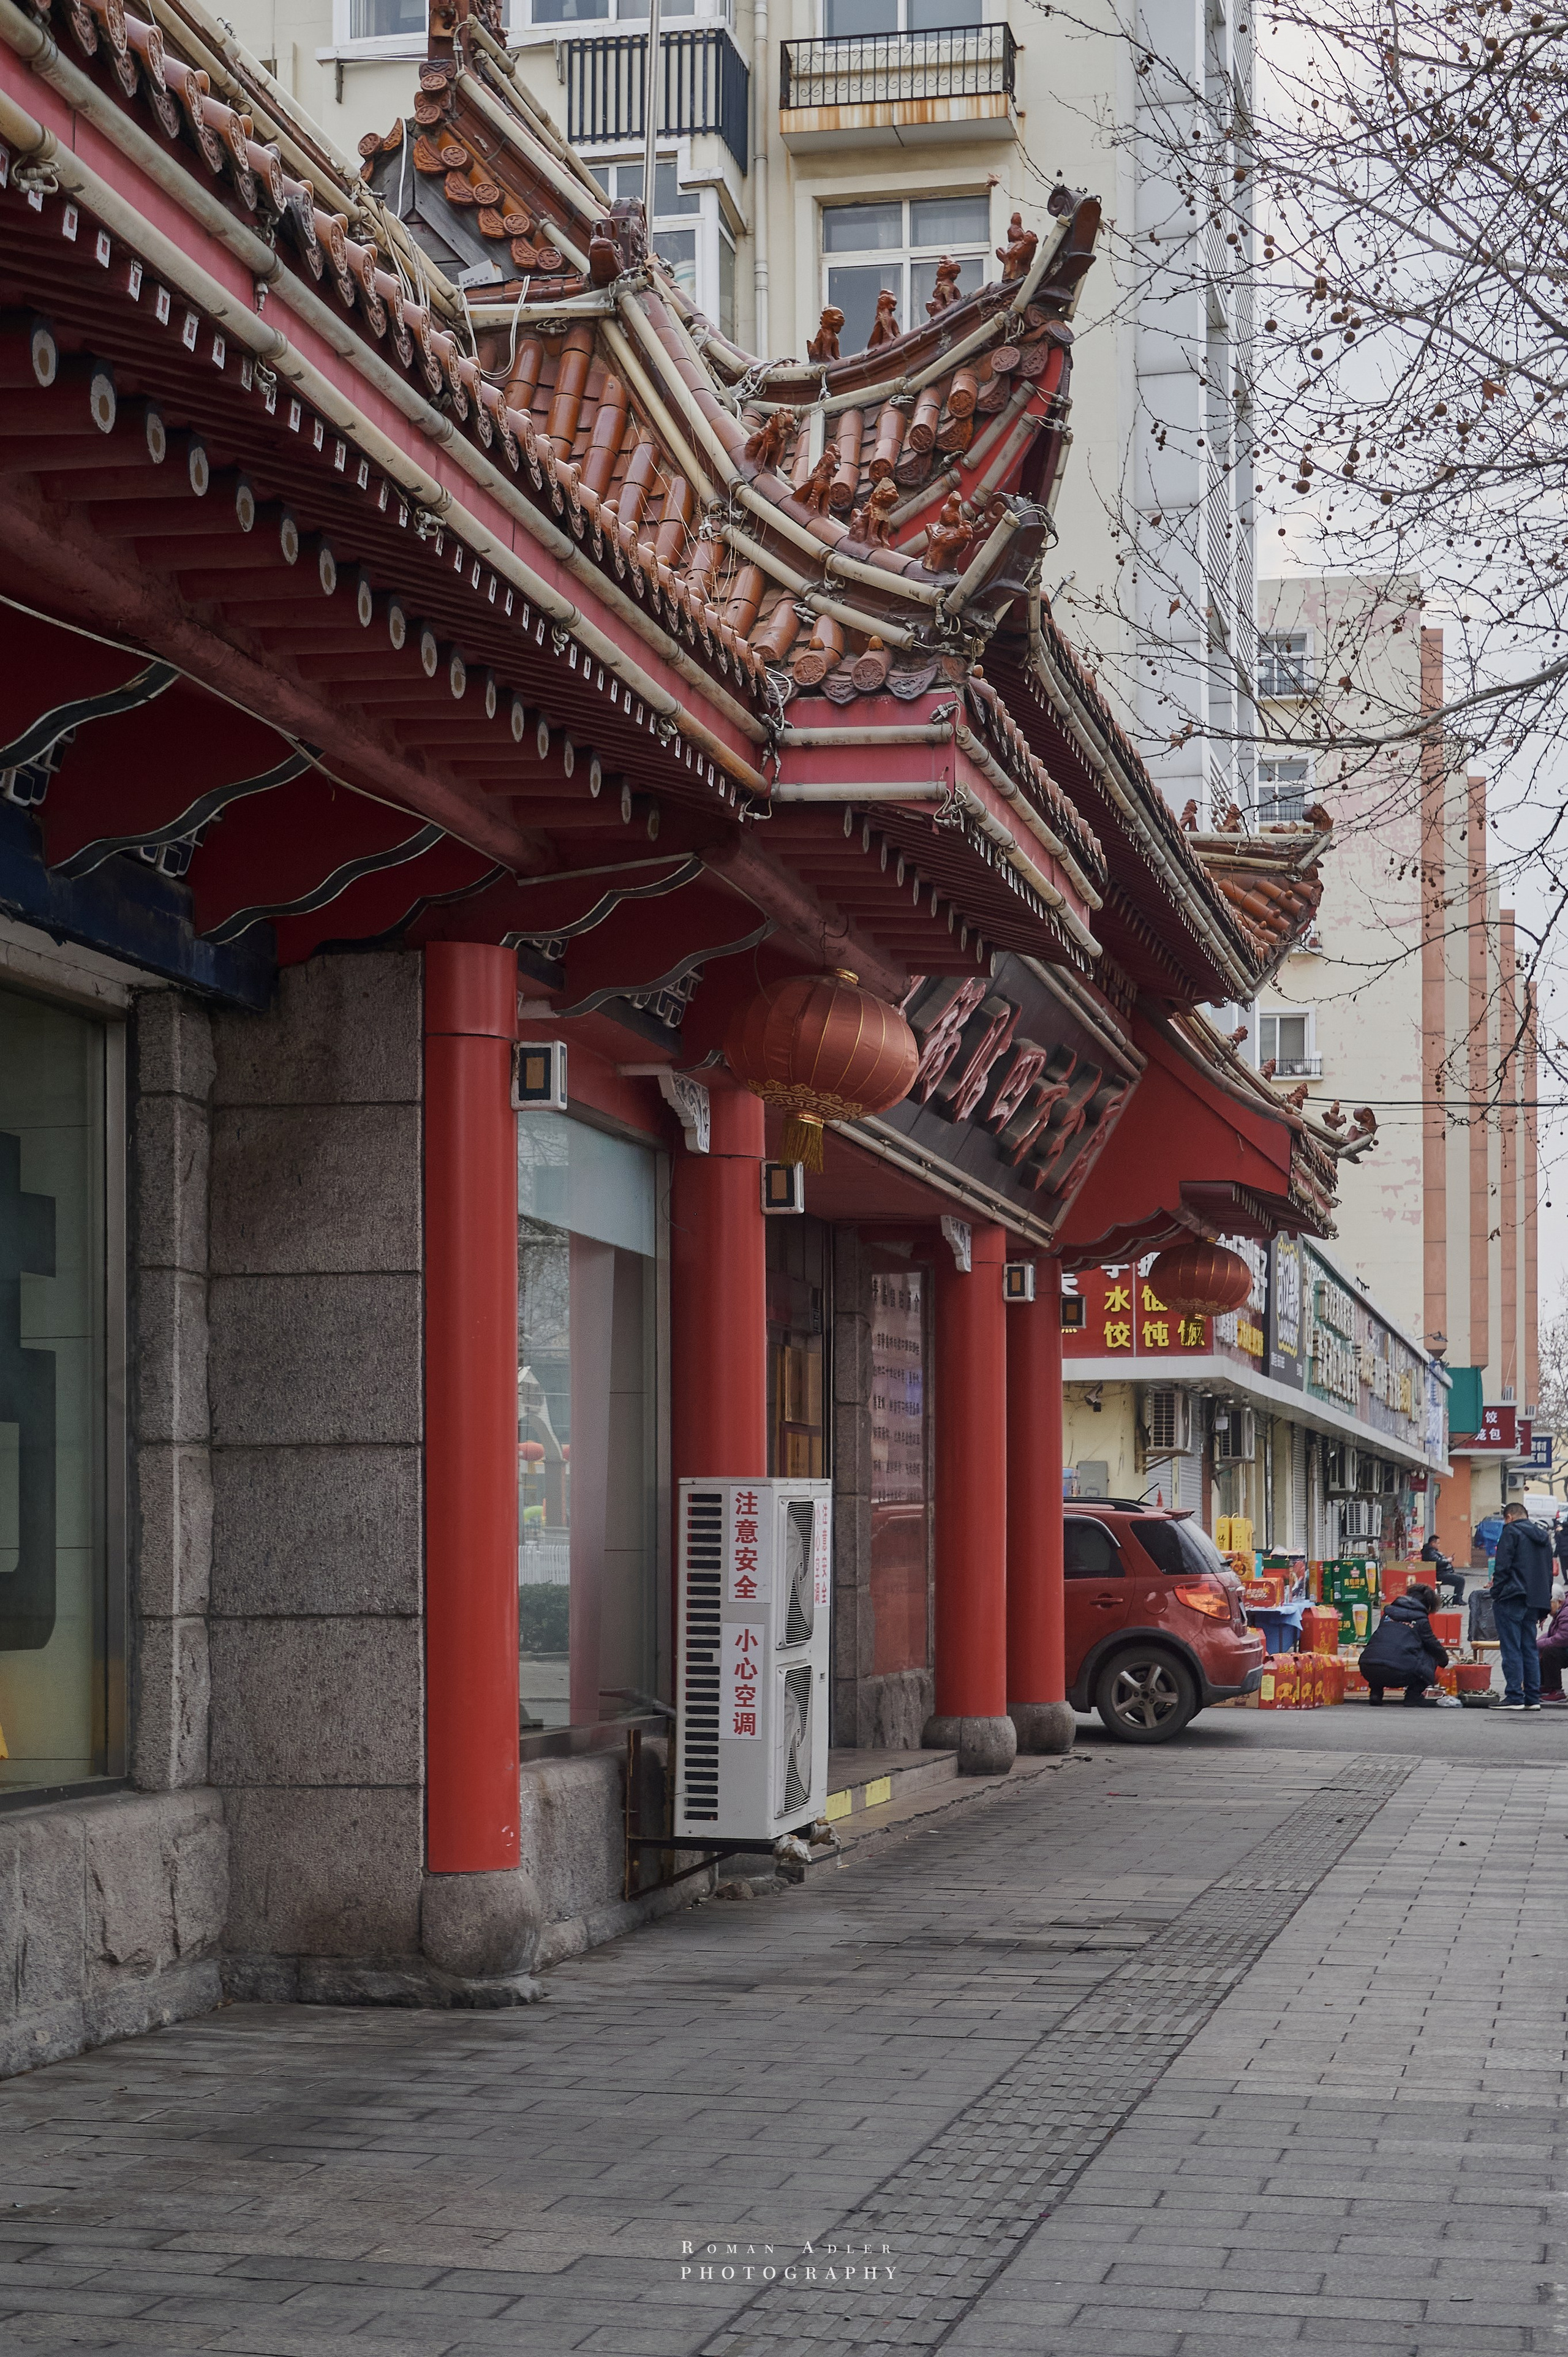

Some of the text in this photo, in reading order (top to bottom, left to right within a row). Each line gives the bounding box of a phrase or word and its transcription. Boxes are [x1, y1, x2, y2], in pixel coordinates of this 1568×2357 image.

[733, 1491, 760, 1600] 注意安全
[733, 1627, 758, 1737] 小心空调
